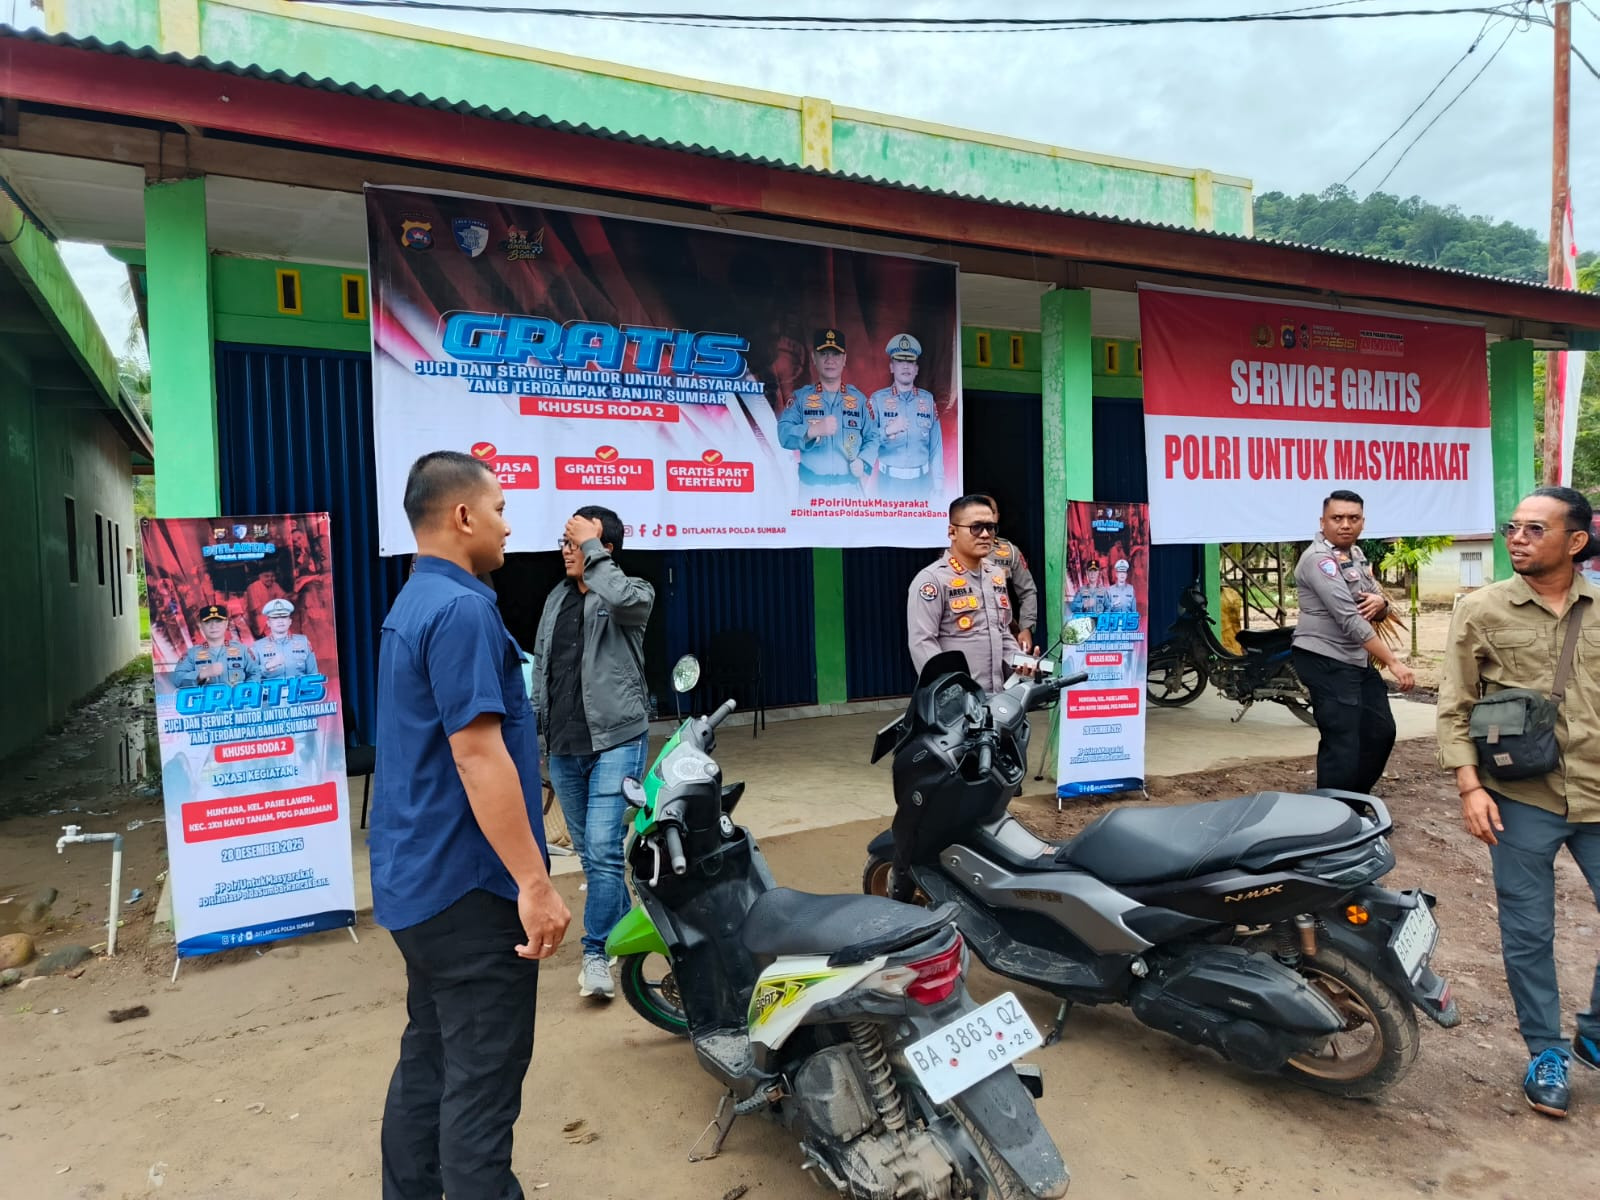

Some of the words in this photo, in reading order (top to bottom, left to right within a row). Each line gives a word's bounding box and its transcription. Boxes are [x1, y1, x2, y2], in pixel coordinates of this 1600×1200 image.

[438, 311, 750, 379] GRATIS
[415, 360, 453, 376] CUCI
[458, 363, 492, 378] DAN
[497, 364, 565, 381] SERVICE
[566, 369, 621, 385] MOTOR
[625, 373, 672, 388] UNTUK
[676, 376, 765, 394] MASYARAKAT
[1231, 359, 1337, 408] SERVICE
[1341, 367, 1421, 414] GRATIS
[467, 378, 509, 393] YANG
[513, 381, 607, 399] TERDAMPAK
[612, 387, 663, 402] BANJIR
[666, 389, 727, 405] SUMBAR
[538, 400, 605, 415] KHUSUS
[608, 404, 653, 417] RODA
[655, 407, 665, 418] 2
[494, 462, 532, 473] JASA
[564, 464, 616, 474] GRATIS
[619, 465, 642, 475] OLI
[1164, 434, 1240, 481] POLRI
[1247, 436, 1328, 481] UNTUK
[1334, 439, 1470, 481] MASYARAKAT
[581, 475, 627, 485] MESIN
[669, 466, 715, 477] GRATIS
[717, 467, 750, 478] PART
[676, 477, 742, 488] TERTENTU
[810, 497, 929, 510] #PolriUntukMasyarakat
[682, 526, 727, 535] DITLANTAS
[729, 526, 756, 535] POLDA
[757, 526, 787, 534] SUMBAR
[176, 673, 328, 715] GRATIS
[164, 719, 184, 733] CUCI
[184, 717, 200, 731] DAN
[201, 713, 233, 729] SERVICE
[235, 711, 263, 725] MOTOR
[264, 708, 289, 722] UNTUK
[290, 702, 338, 719] MASYARAKAT
[210, 727, 257, 743] TERDAMPAK
[258, 723, 286, 737] BANJIR
[286, 719, 318, 734] SUMBAR
[222, 743, 256, 758] KHUSUS
[257, 742, 280, 755] RODA
[280, 741, 287, 751] 2
[211, 772, 246, 786] LOKASI
[248, 767, 293, 782] KEGIATAN
[189, 822, 208, 832] KEC.
[224, 817, 246, 828] KAYU
[246, 812, 276, 824] TANAM,
[276, 809, 293, 819] PDG
[294, 803, 333, 817] PARIAMAN
[221, 849, 234, 863] 28
[235, 843, 280, 861] DESEMBER
[281, 838, 304, 854] 2025
[912, 1045, 943, 1071] BA
[945, 1016, 993, 1054] 3863
[996, 1000, 1023, 1025] QZ
